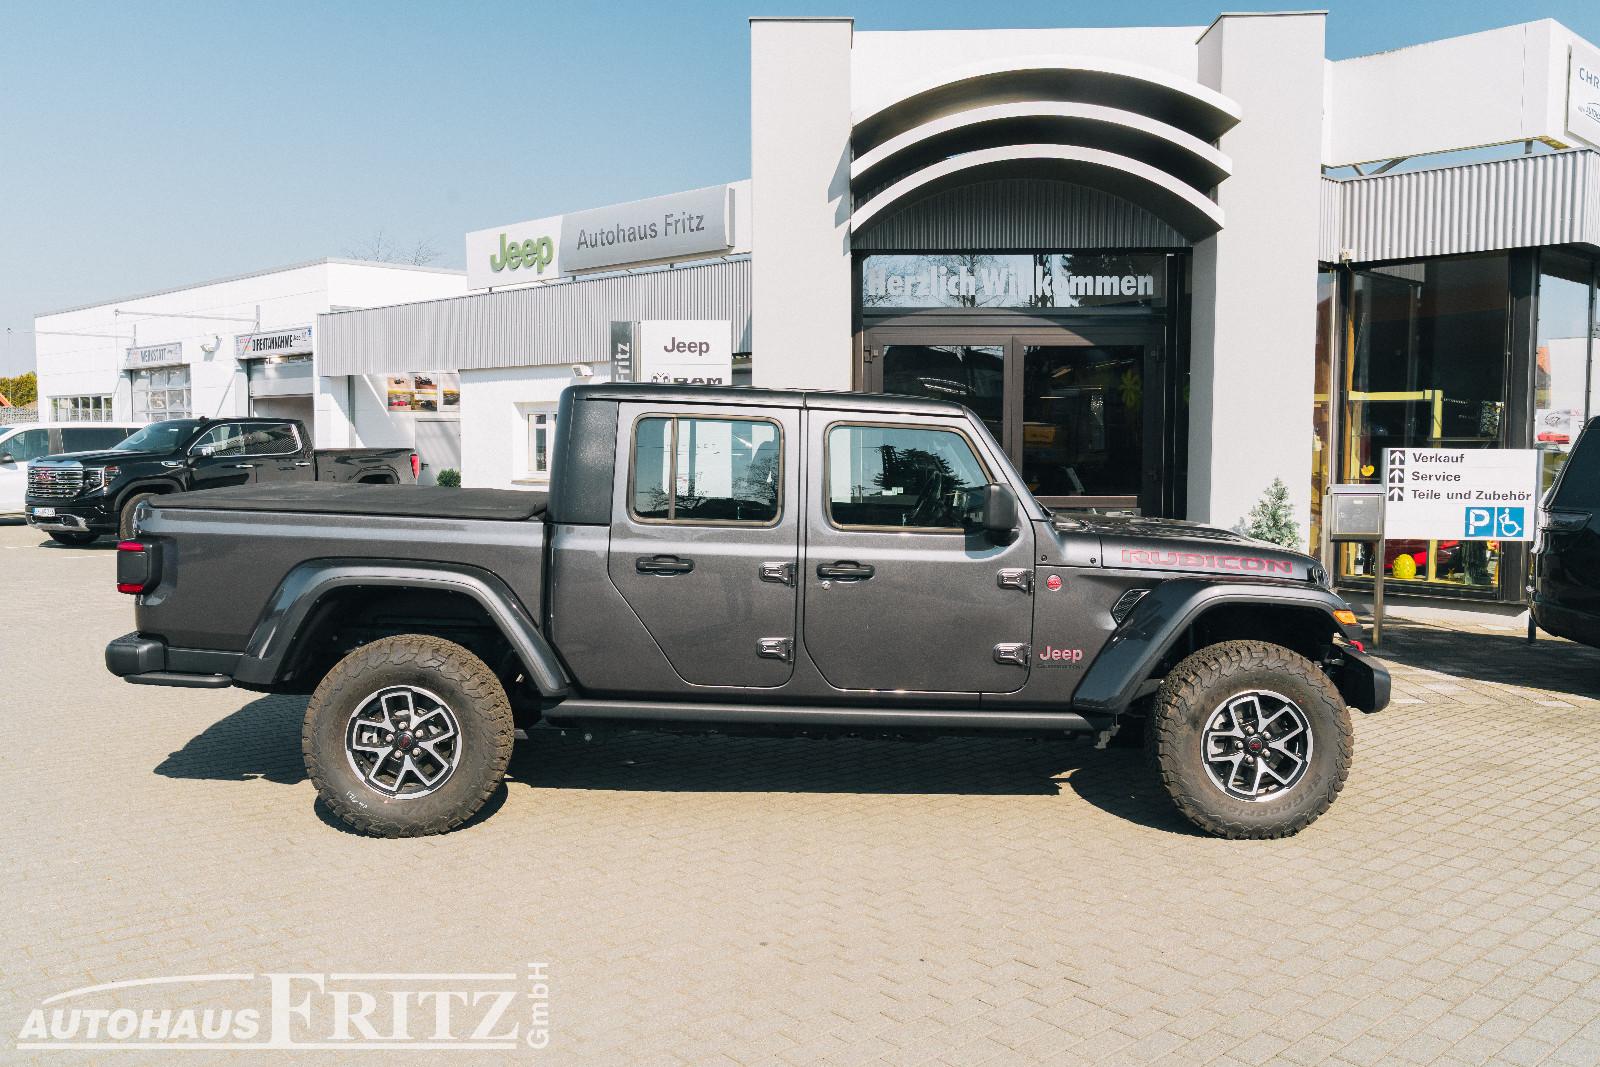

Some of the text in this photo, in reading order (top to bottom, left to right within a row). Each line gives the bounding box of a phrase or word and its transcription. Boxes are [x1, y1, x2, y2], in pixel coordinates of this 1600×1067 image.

[1579, 67, 1600, 88] CHR
[577, 211, 705, 250] Autohaus Fritz
[490, 232, 554, 274] Jeep
[869, 265, 1154, 297] Herzlich Willkommen
[663, 336, 710, 356] Jeep
[614, 342, 630, 382] Fritz
[1412, 452, 1465, 464] Verkauf
[1411, 471, 1461, 482] Service
[1411, 489, 1532, 502] Teile und Zubehör
[1468, 509, 1490, 535] P
[1121, 548, 1293, 574] RUBICON
[1039, 645, 1083, 663] Jeep
